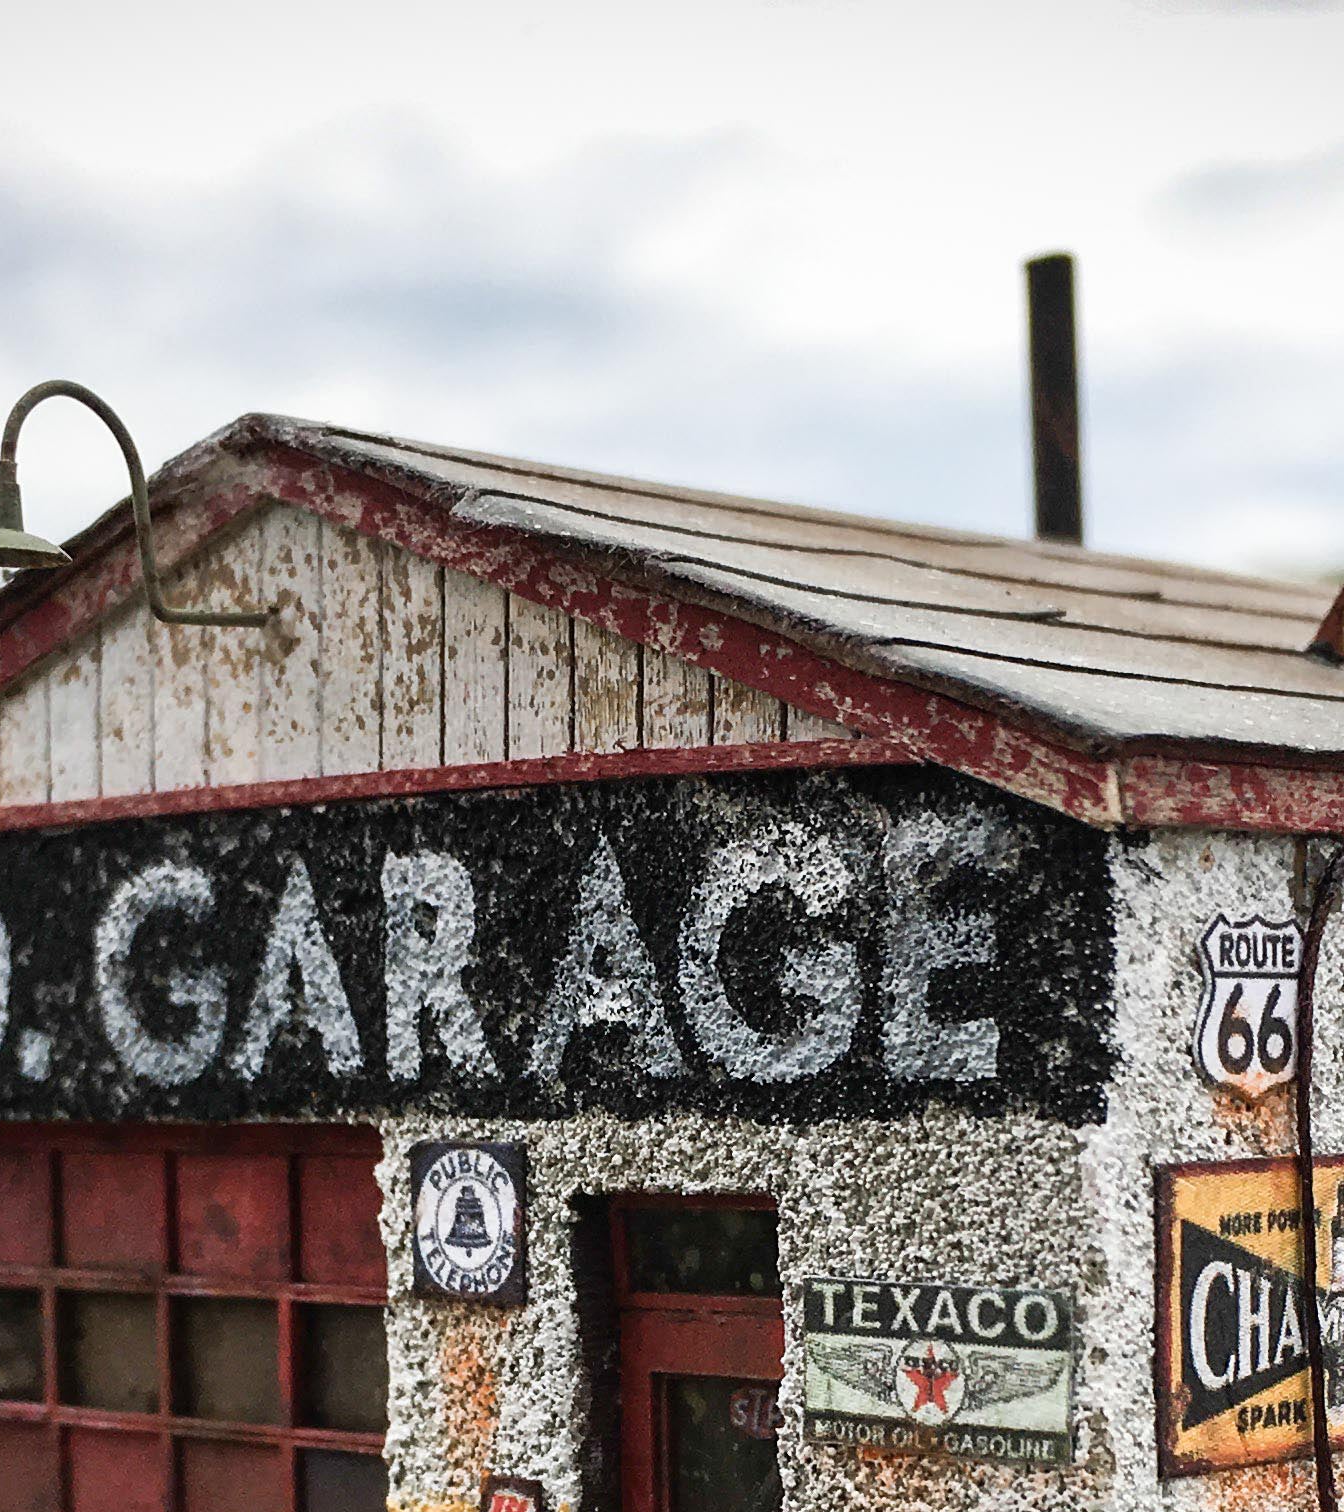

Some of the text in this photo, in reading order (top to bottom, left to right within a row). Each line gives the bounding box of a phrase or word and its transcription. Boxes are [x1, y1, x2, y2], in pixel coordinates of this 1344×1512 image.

[93, 804, 1020, 1087] GARAGE
[1218, 931, 1296, 969] ROUTE
[1217, 982, 1293, 1075] 66
[428, 1150, 510, 1191] PUBLIC
[1218, 1205, 1322, 1237] MORE POWR
[420, 1226, 515, 1293] TELEPHONE
[811, 1280, 1058, 1342] TEXACO
[813, 1418, 1057, 1461] MOTOR OIL GASOLINE
